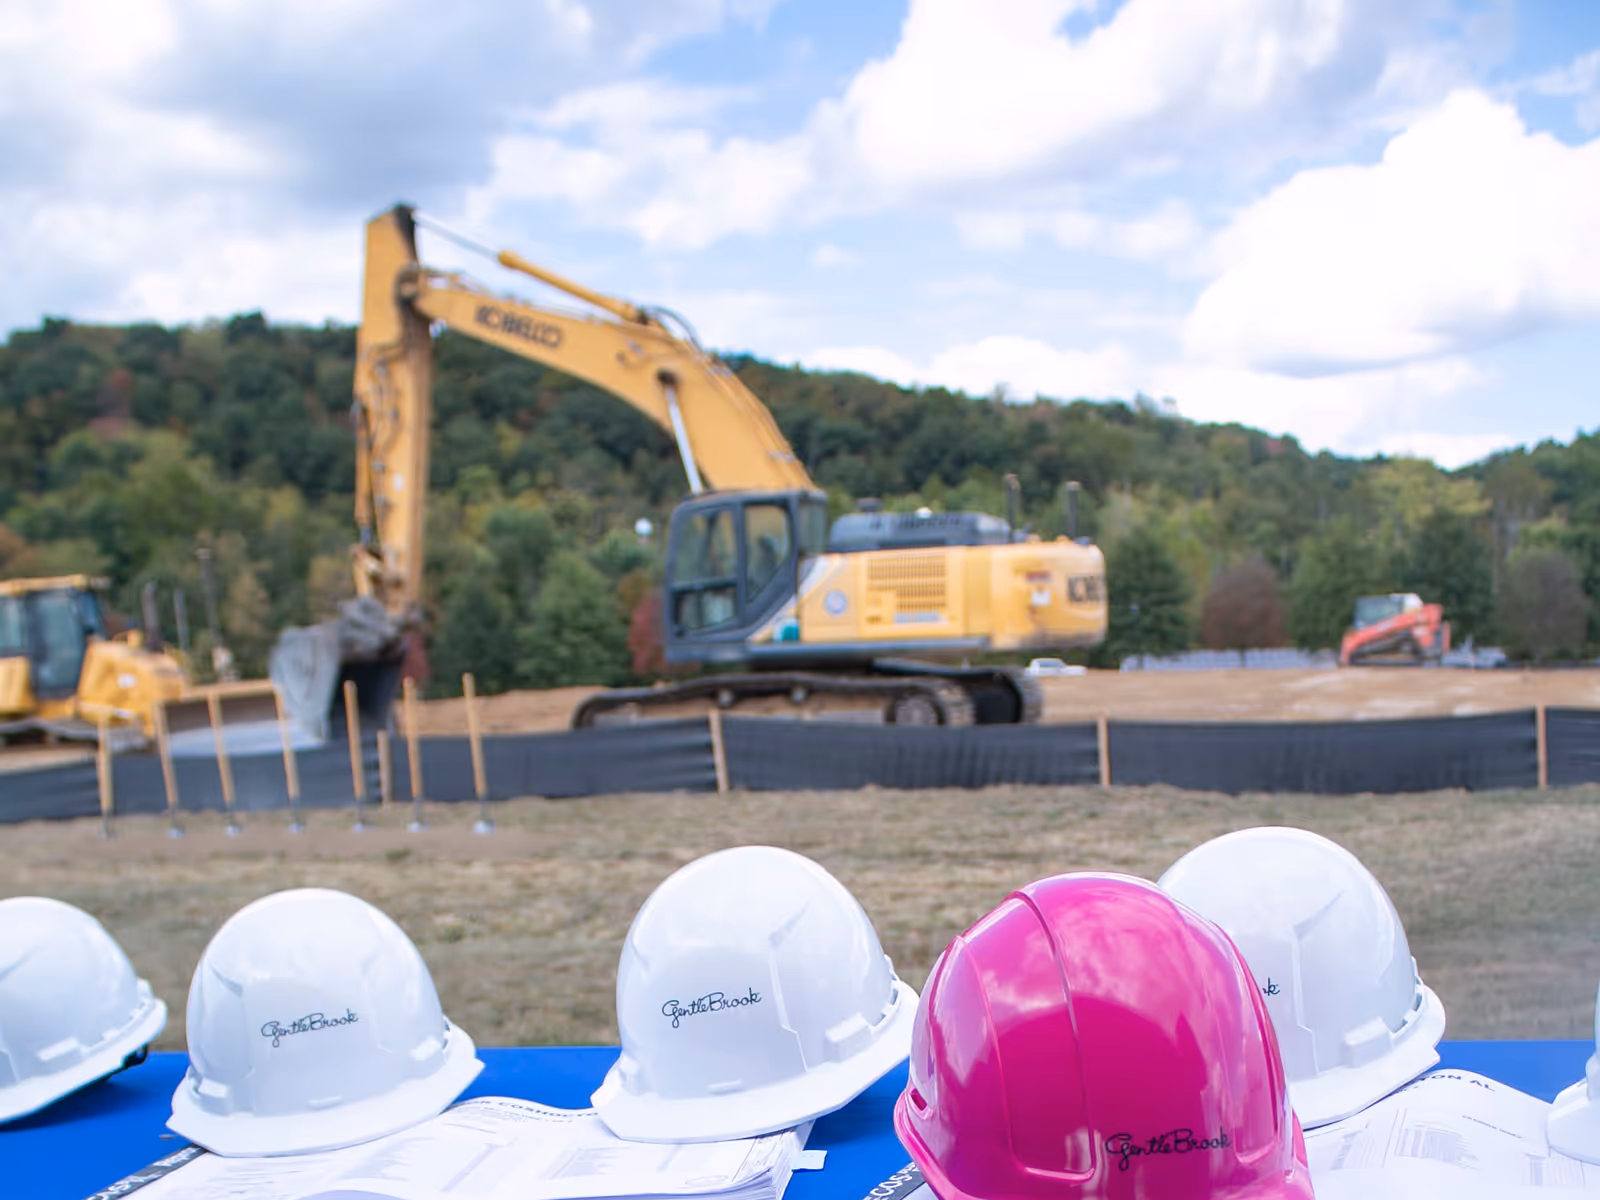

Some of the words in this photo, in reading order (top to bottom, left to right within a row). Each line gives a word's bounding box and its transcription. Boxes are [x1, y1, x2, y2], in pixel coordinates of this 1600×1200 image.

[260, 1007, 359, 1048] GentleBrook
[661, 986, 762, 1029] GentleBrook
[1105, 1125, 1231, 1172] GentleBrook
